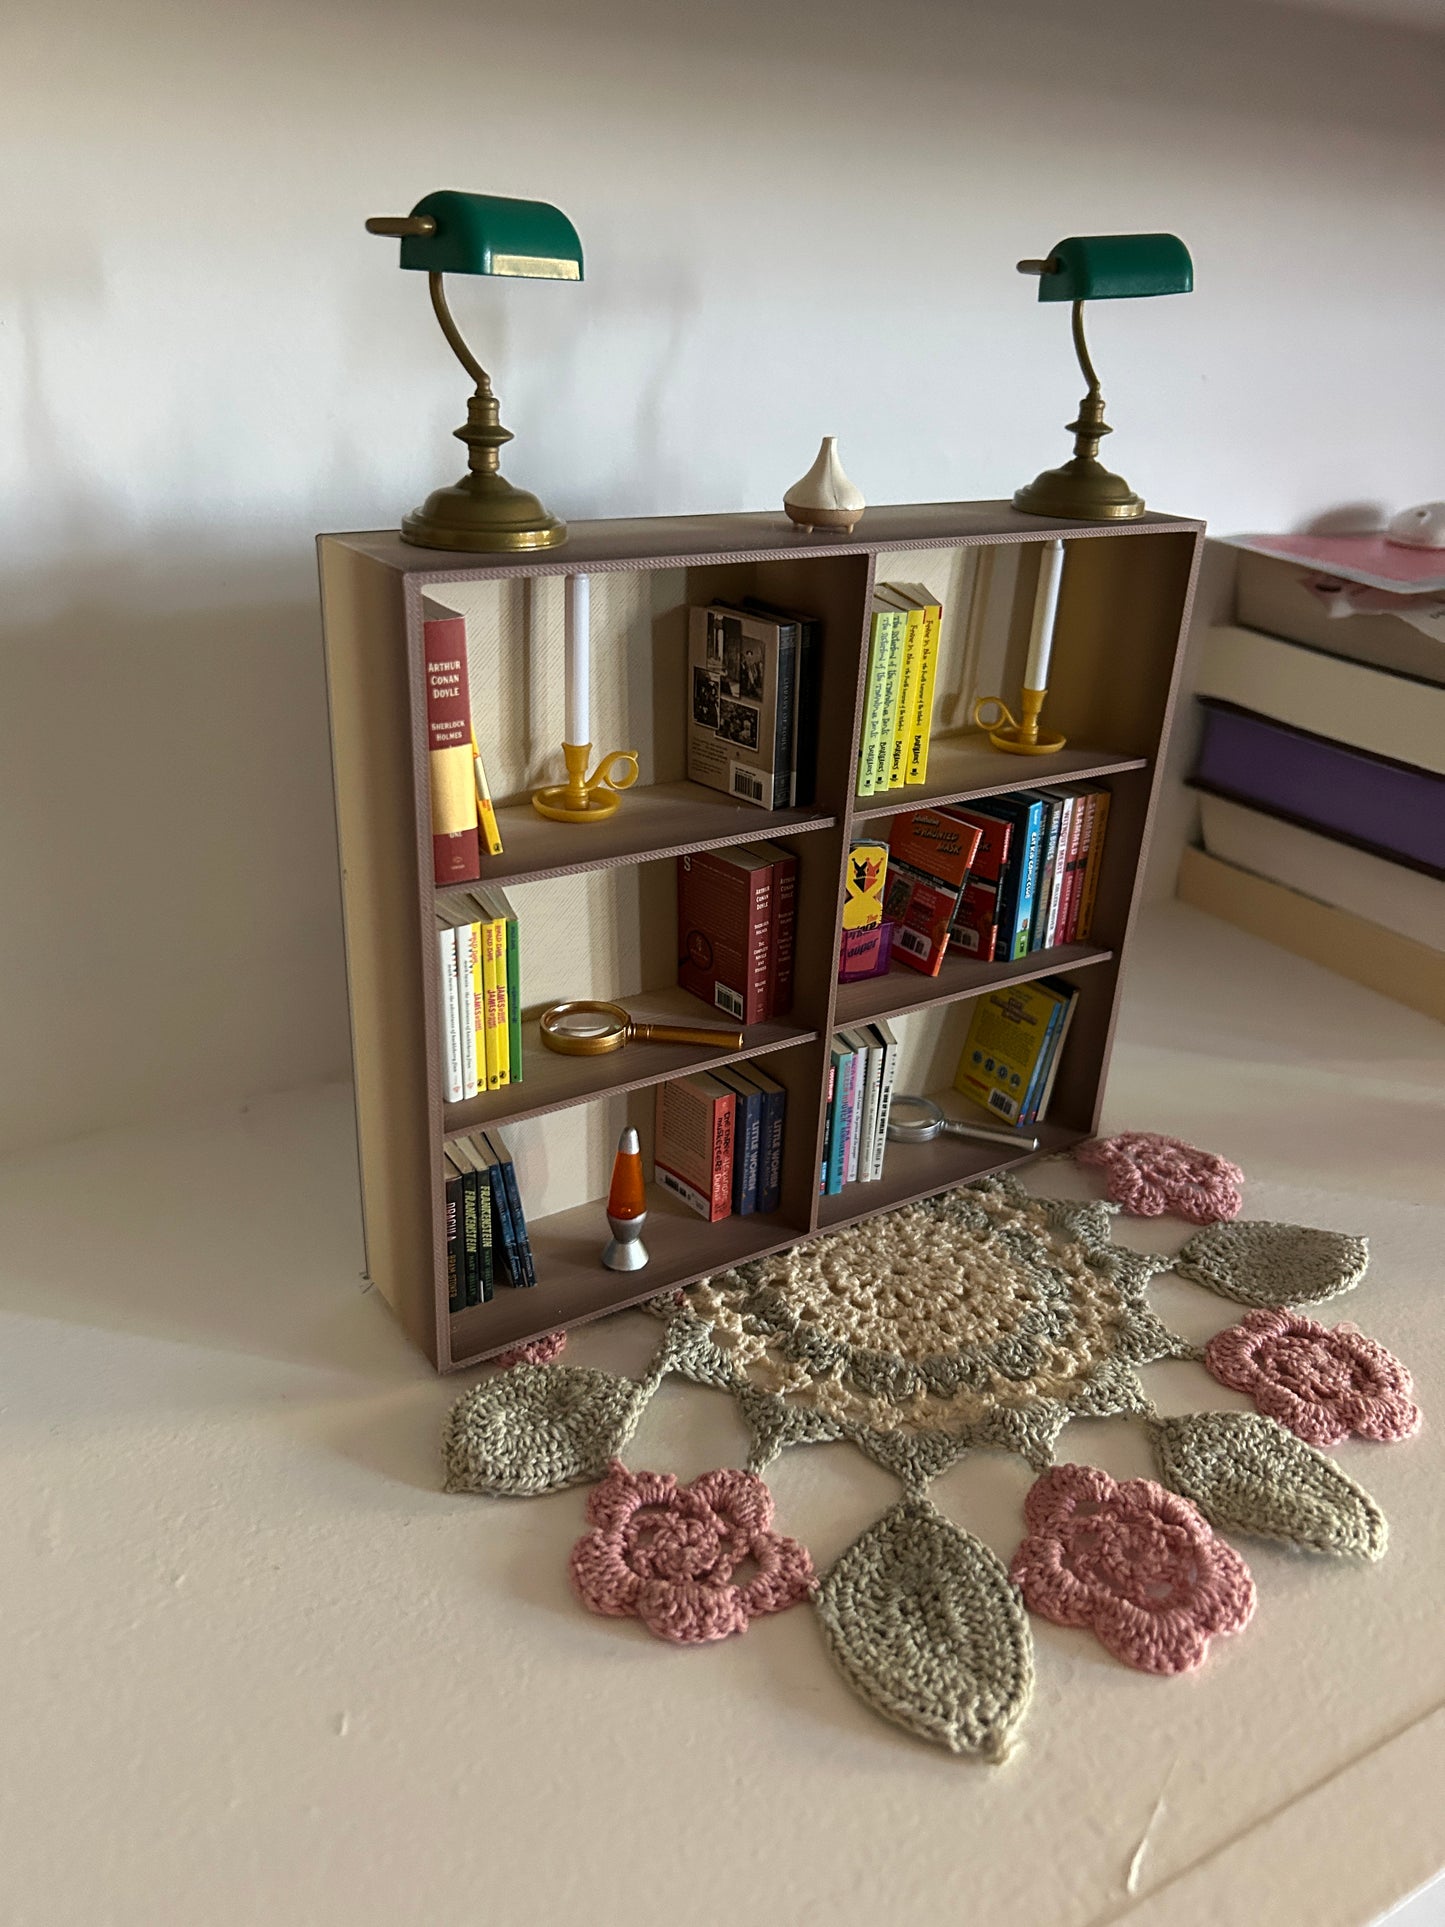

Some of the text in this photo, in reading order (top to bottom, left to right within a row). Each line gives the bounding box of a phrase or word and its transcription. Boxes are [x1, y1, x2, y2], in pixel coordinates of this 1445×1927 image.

[428, 660, 461, 672] ARTHUR
[431, 674, 460, 686] CONAN
[433, 687, 460, 699] DOYLE
[431, 720, 465, 731] SHERLOCK
[436, 731, 462, 742] HOLMES
[1070, 805, 1084, 855] SLAMMED
[1082, 803, 1096, 852] SLAMMED
[1056, 811, 1070, 875] WITHOUT MERIT
[474, 992, 482, 1015] JAMES
[487, 989, 496, 1013] JAMES
[496, 985, 506, 1009] JAMES
[748, 1120, 760, 1191] LITTLE WOMEN
[770, 1119, 782, 1189] LITTLE WOMEN
[464, 1190, 477, 1253] FRANKENSTEIN
[480, 1185, 492, 1248] FRANKENSTEIN
